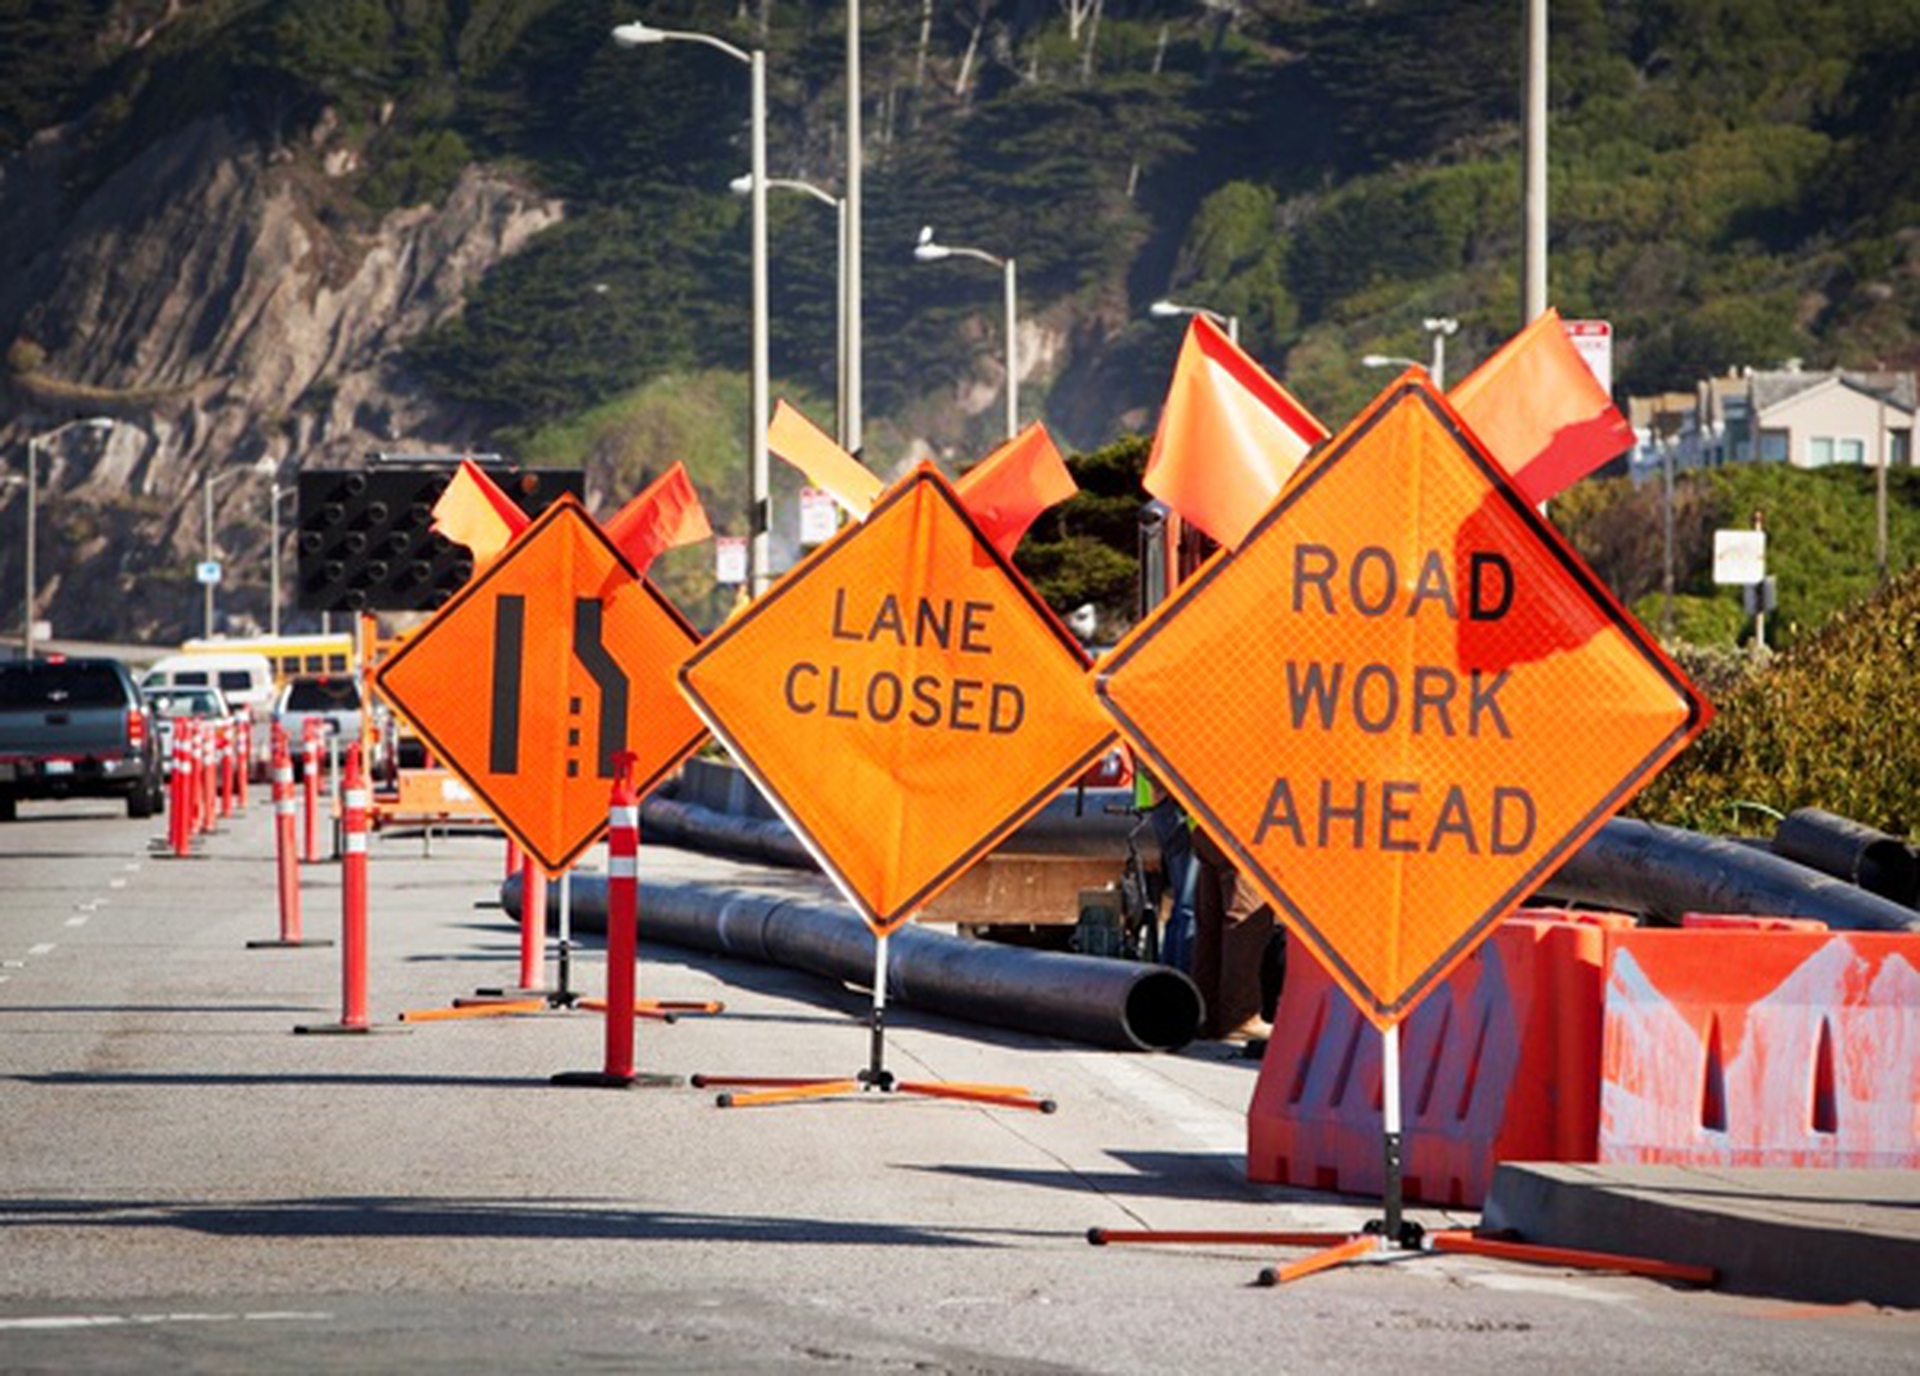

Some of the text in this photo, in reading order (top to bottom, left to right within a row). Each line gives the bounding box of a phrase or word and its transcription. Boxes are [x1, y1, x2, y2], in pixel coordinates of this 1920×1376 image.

[833, 589, 994, 654] LANE
[1292, 544, 1517, 623] ROAD
[784, 663, 1025, 735] CLOSED
[1286, 662, 1512, 739] WORK
[1252, 777, 1537, 856] AHEAD
